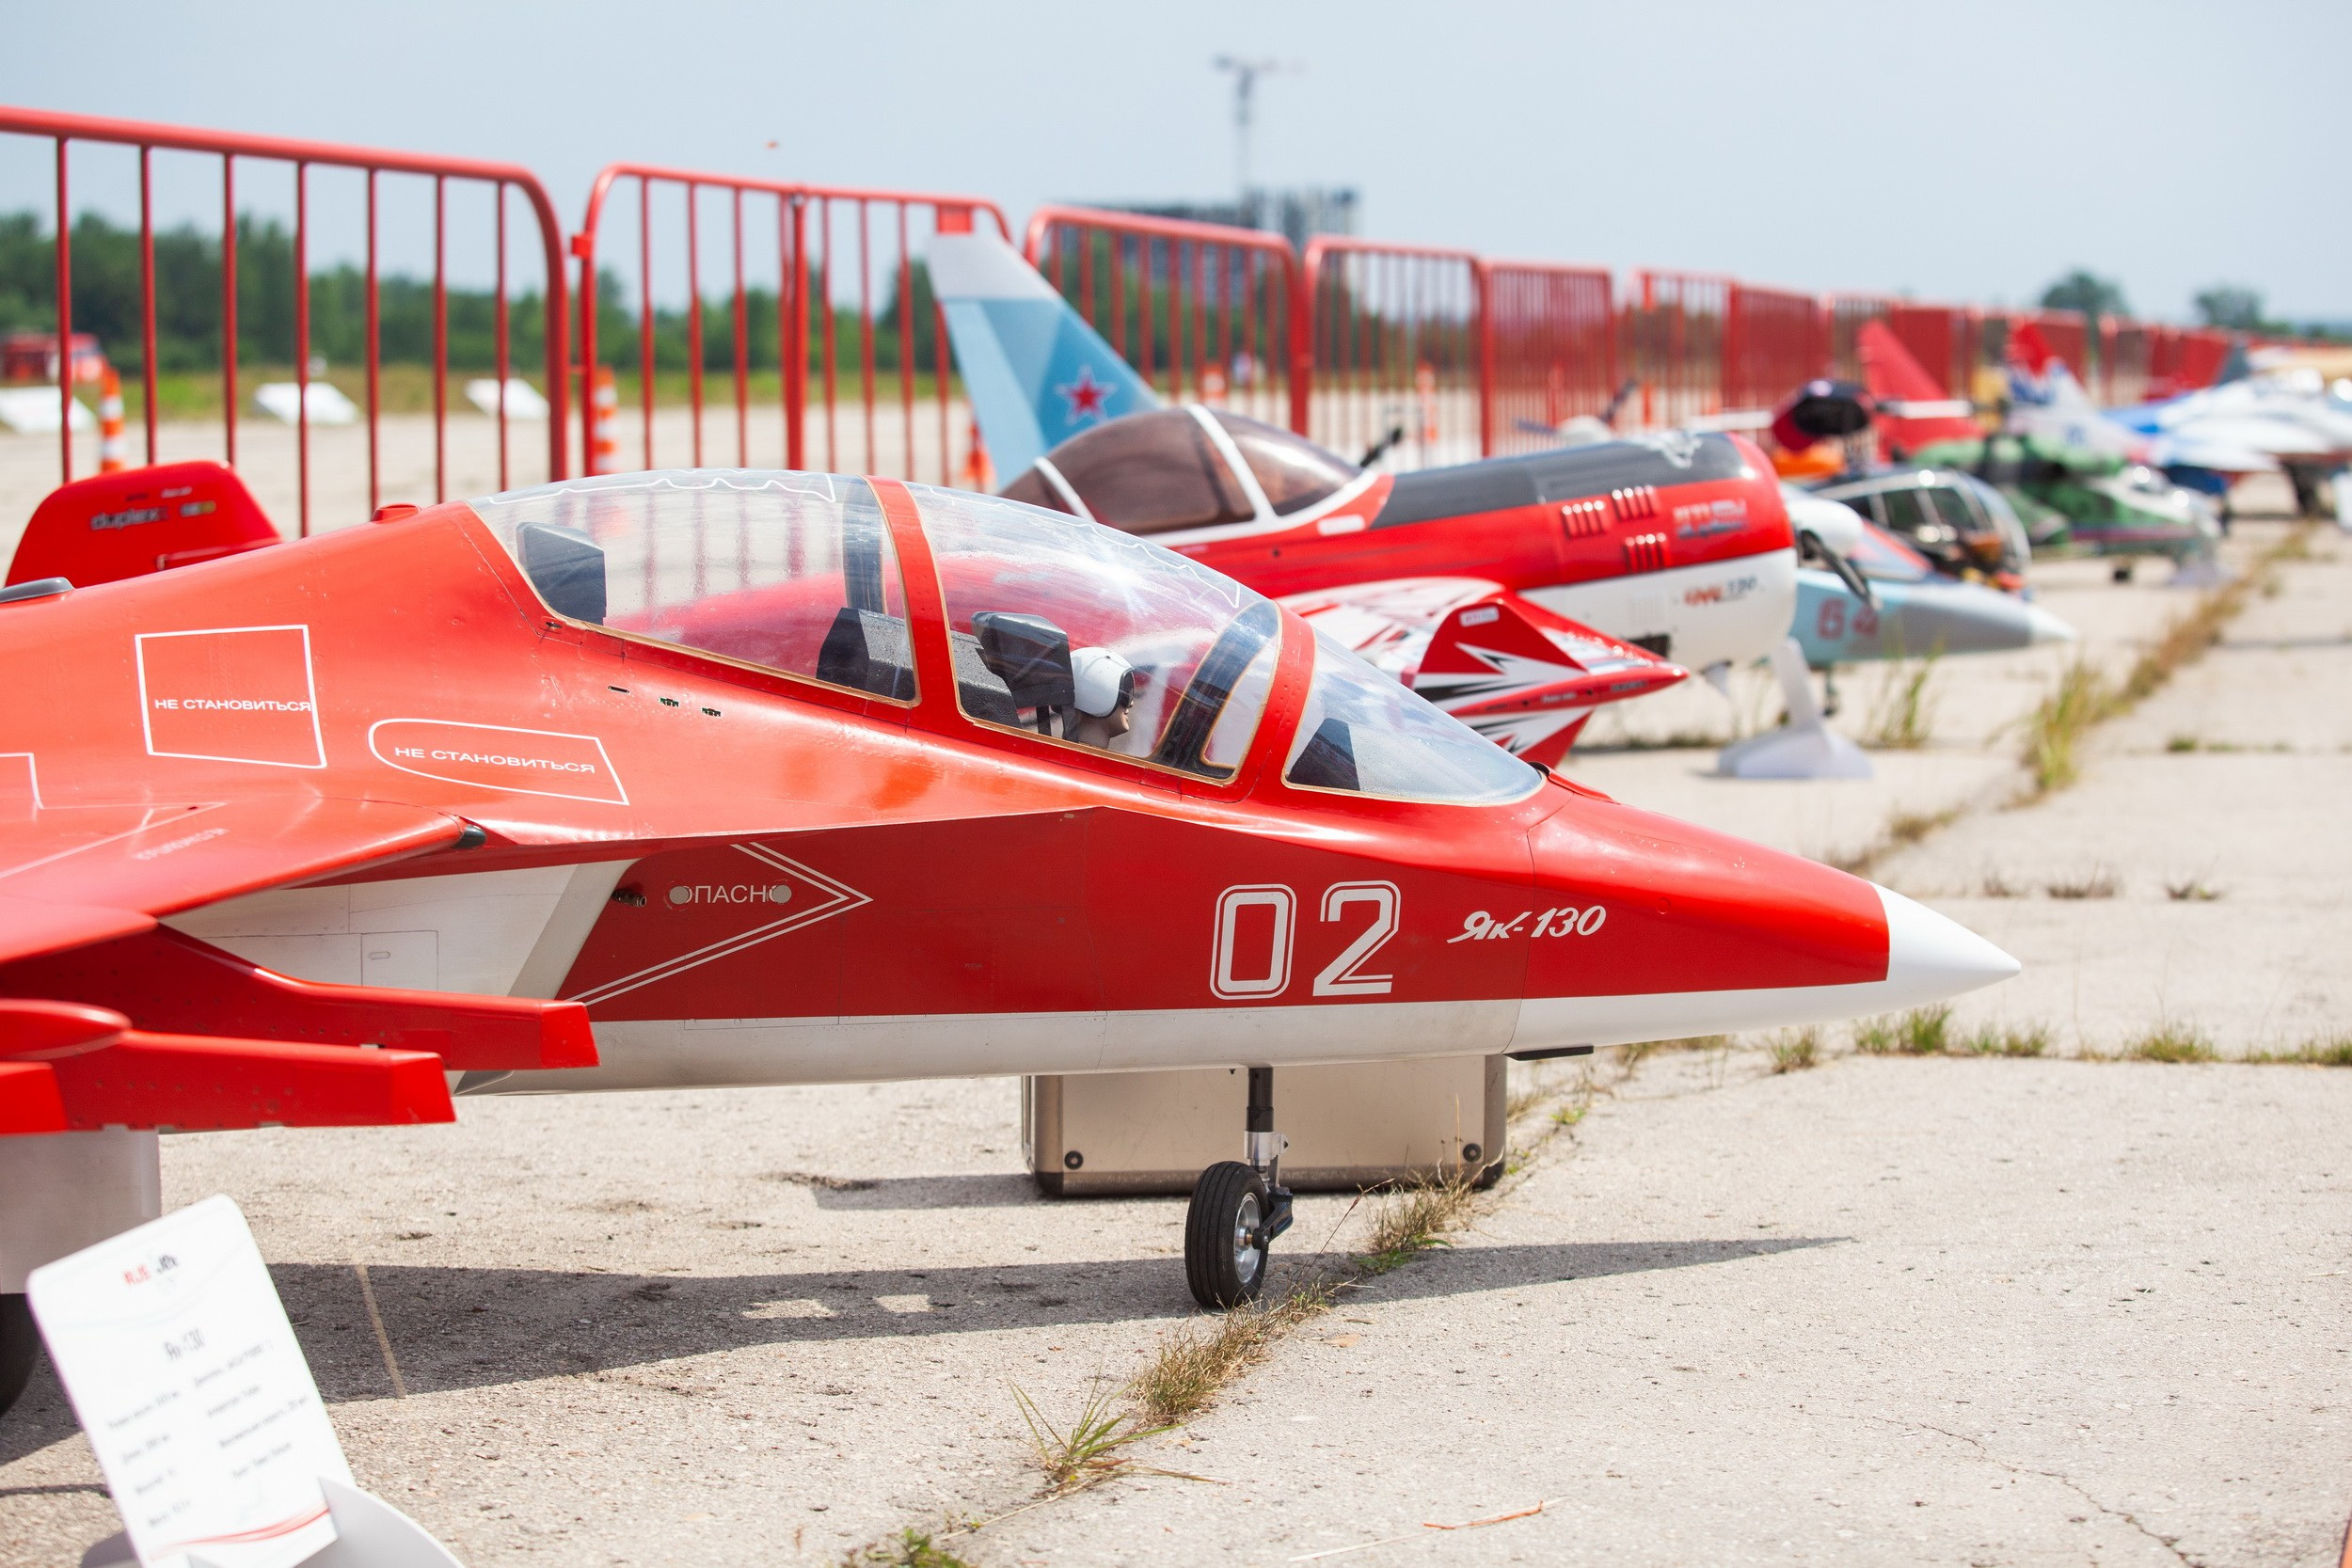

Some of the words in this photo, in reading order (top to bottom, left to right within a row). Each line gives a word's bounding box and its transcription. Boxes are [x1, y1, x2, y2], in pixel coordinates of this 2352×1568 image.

[153, 699, 179, 709] НЕ
[183, 699, 312, 712] СТАНОВИТЬСЯ
[394, 747, 426, 759] НЕ
[431, 750, 596, 774] СТАНОВИТЬСЯ
[669, 884, 792, 905] ПАСН
[1446, 905, 1607, 943] Як-130
[1209, 879, 1402, 1001] 02
